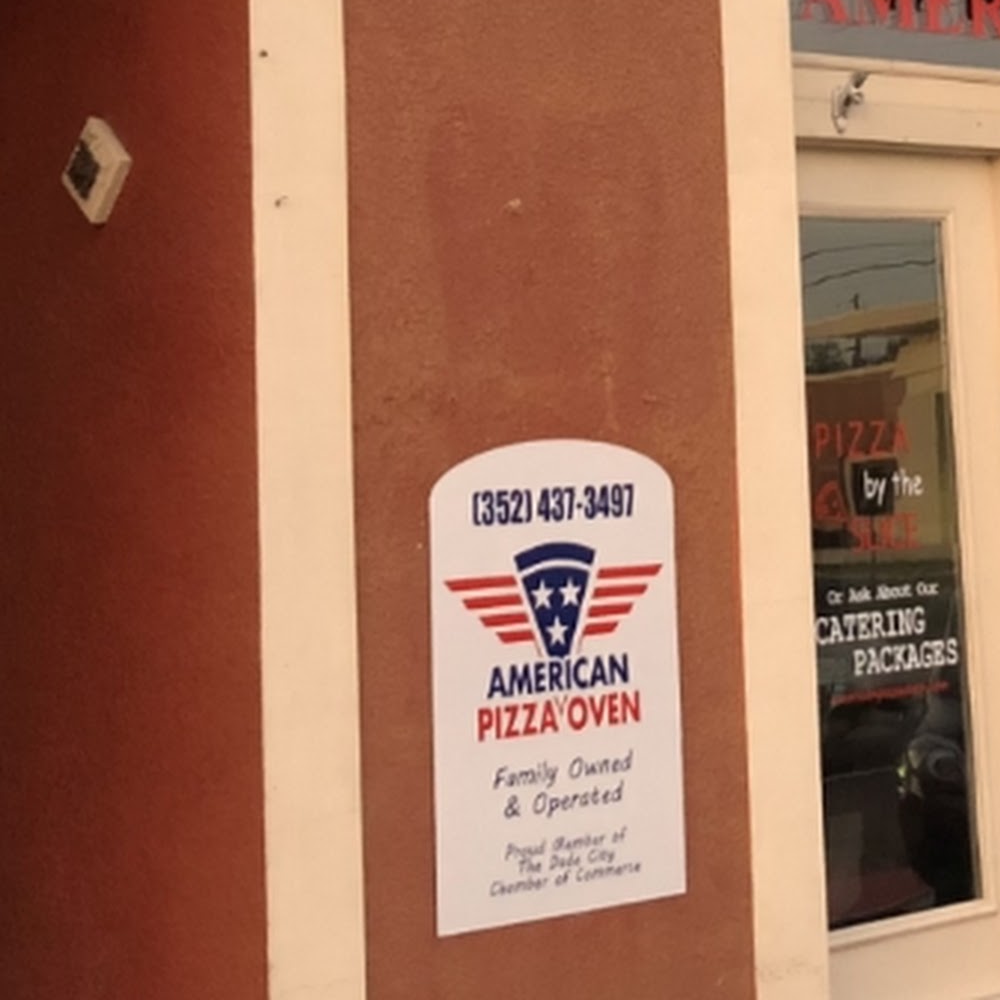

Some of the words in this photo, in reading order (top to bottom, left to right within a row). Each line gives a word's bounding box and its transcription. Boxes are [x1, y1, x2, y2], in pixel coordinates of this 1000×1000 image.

[815, 420, 911, 459] PIZZA
[472, 489, 532, 526] (352)
[537, 483, 635, 522] 437-3497
[862, 468, 887, 505] by
[890, 467, 924, 496] the
[826, 589, 844, 605] Or
[848, 586, 872, 603] Ask
[875, 583, 912, 601] About
[916, 580, 940, 597] Our
[814, 606, 926, 645] CATERING
[486, 653, 630, 700] AMERICAN
[852, 638, 958, 676] PACKAGES
[477, 700, 559, 743] PIZZA
[566, 690, 642, 732] OVEN
[493, 760, 559, 790] Family
[567, 748, 634, 780] Owned
[503, 795, 521, 819] &
[532, 780, 624, 818] Operated
[611, 825, 628, 843] of
[489, 875, 549, 897] Chamber
[554, 869, 570, 887] of
[575, 861, 642, 883] Commerce
